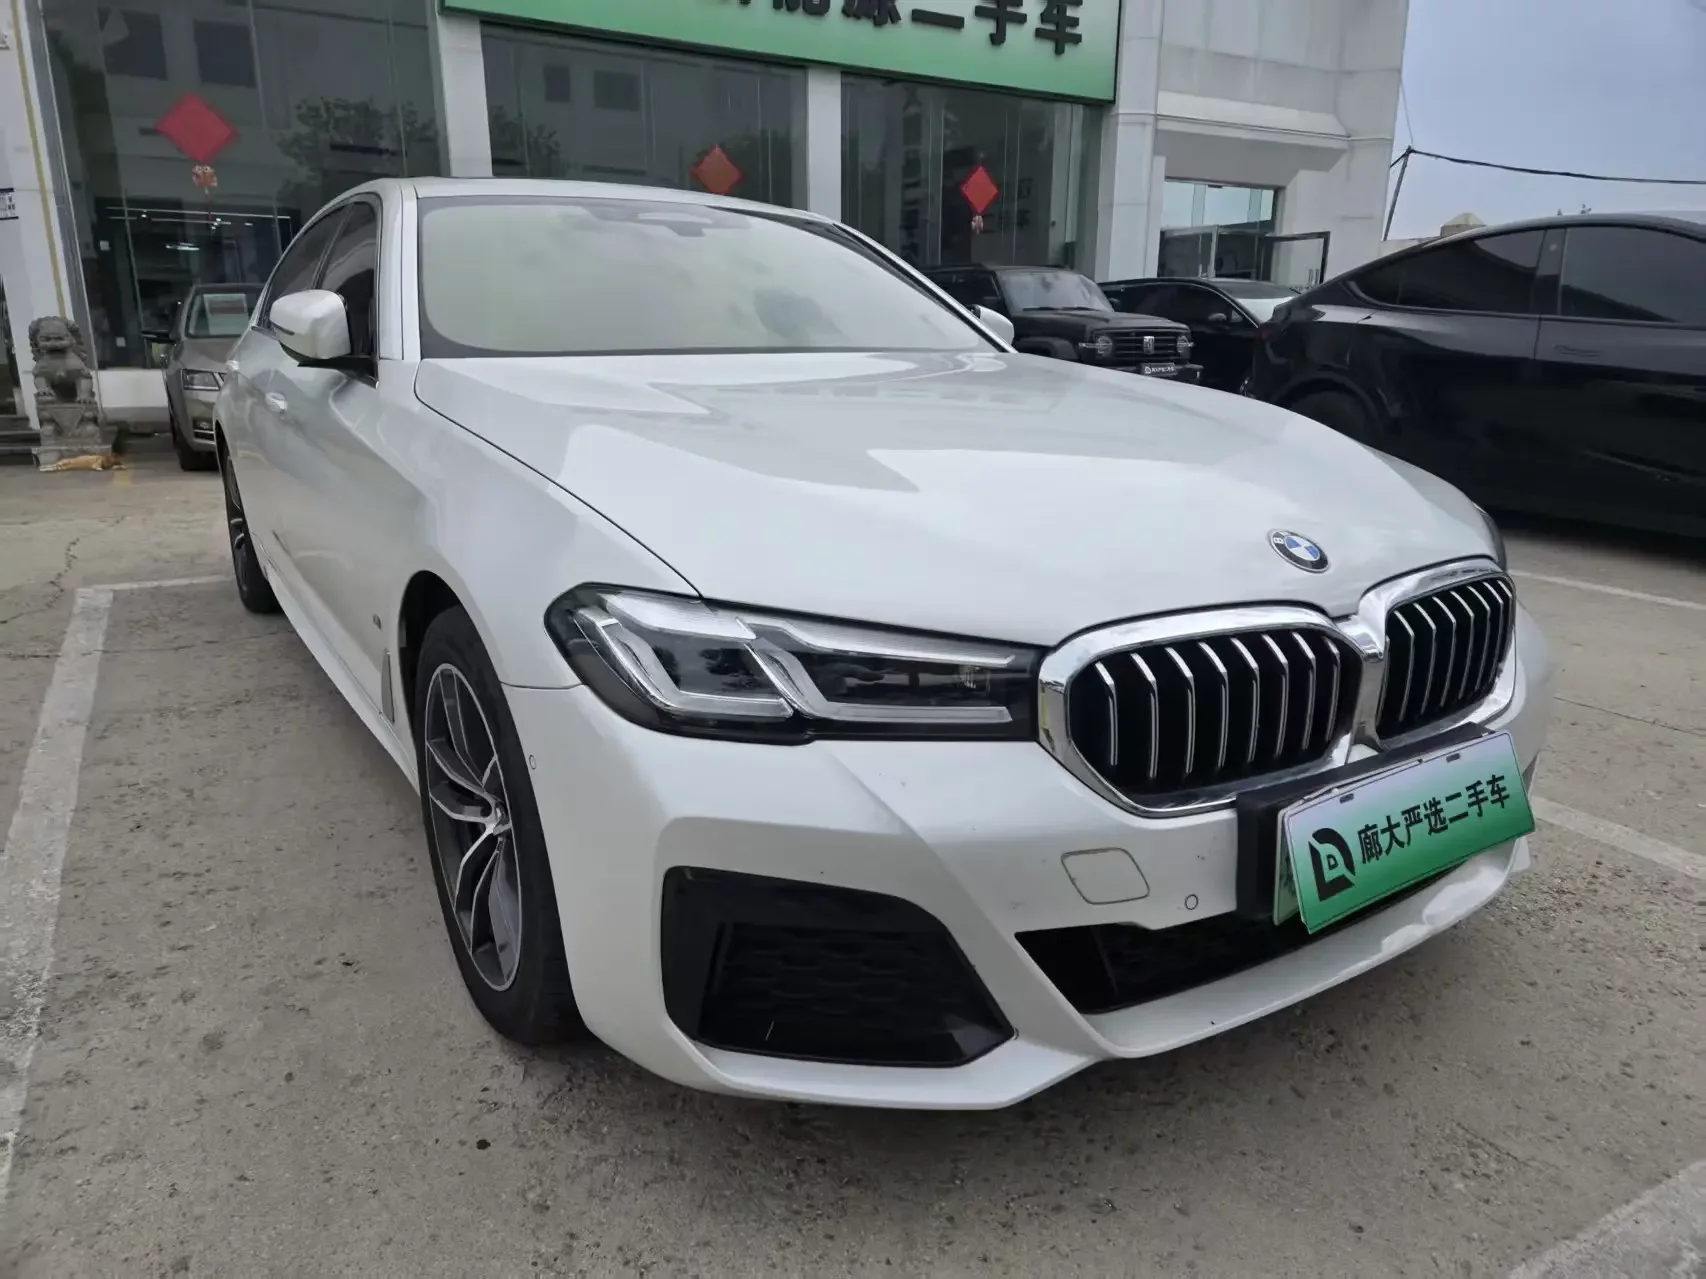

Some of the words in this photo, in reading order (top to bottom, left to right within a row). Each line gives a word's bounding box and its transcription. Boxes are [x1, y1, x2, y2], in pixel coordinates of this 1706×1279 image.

[1358, 774, 1510, 864] 廊大严选二手车
